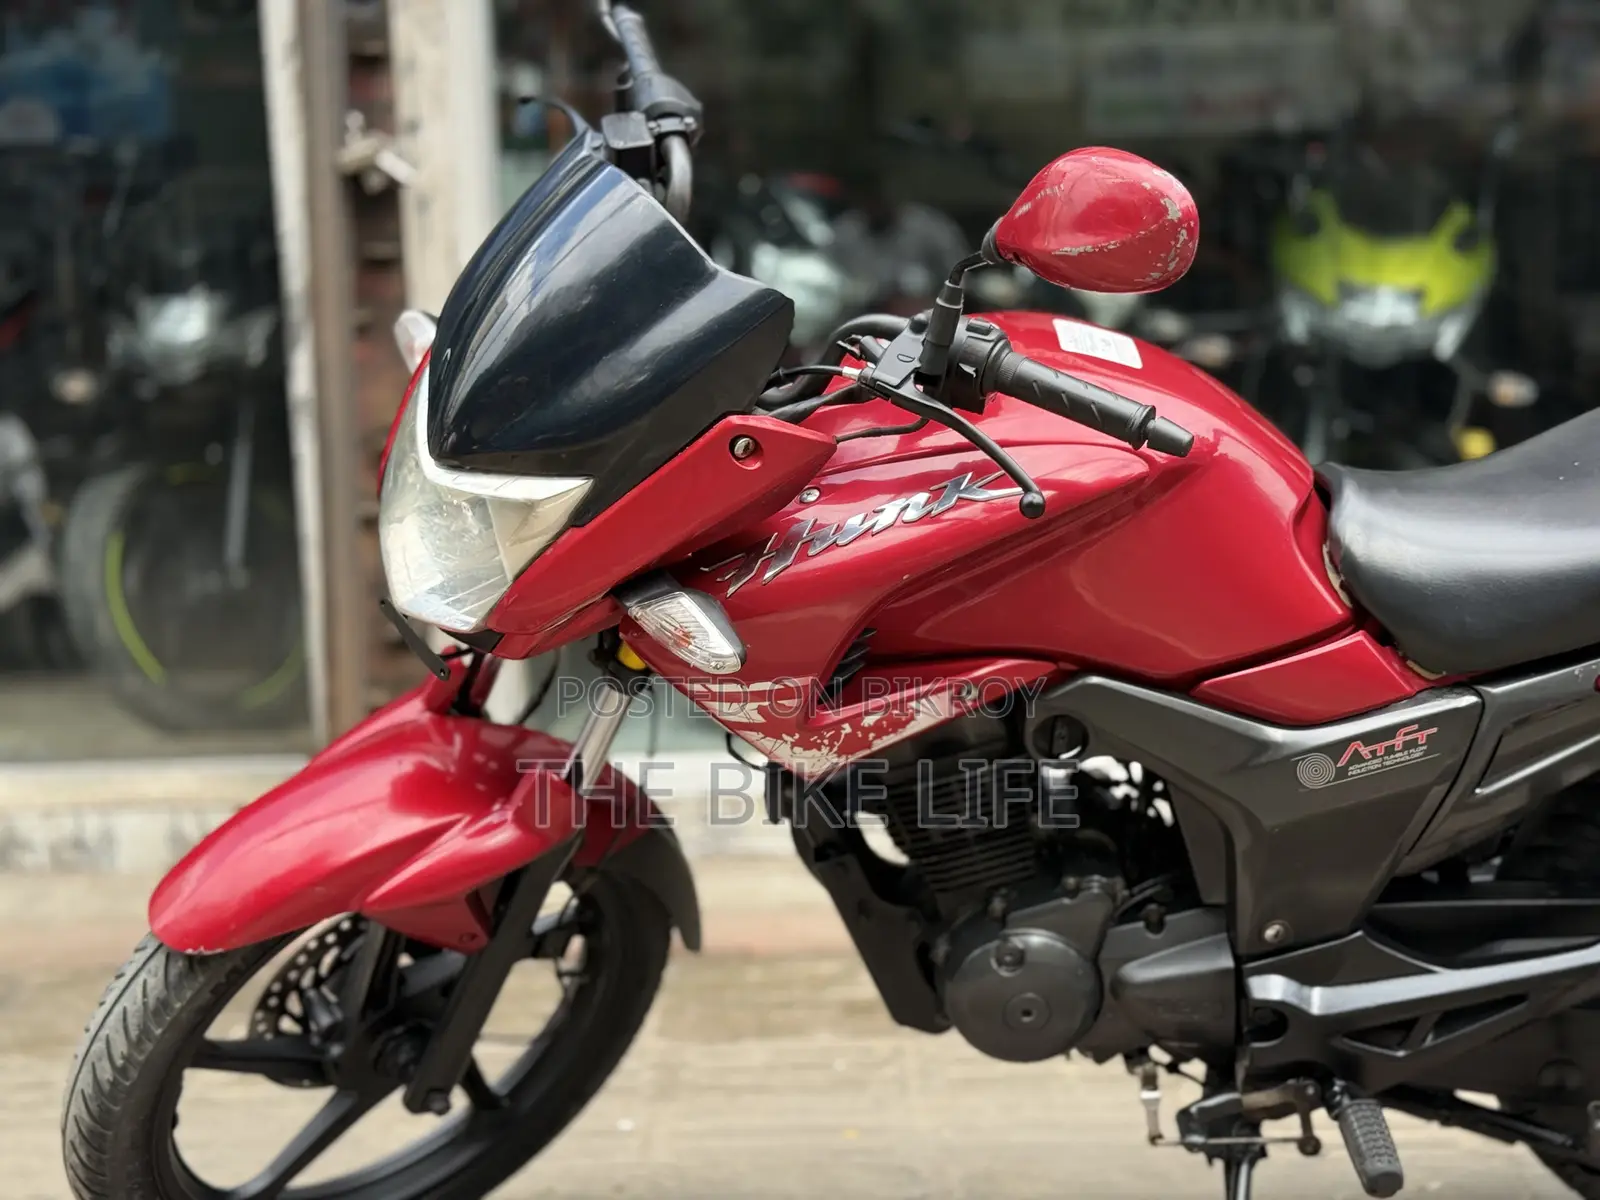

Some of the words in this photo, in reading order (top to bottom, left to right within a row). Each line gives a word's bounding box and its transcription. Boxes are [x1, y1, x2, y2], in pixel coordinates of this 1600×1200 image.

[700, 471, 1024, 598] Hunk
[1348, 757, 1382, 771] ADVANCED
[1383, 750, 1409, 762] TUMBLE
[1409, 745, 1428, 754] FLOW
[1348, 763, 1382, 776] INDUCTION
[1383, 751, 1425, 767] TECHNOLOGY
